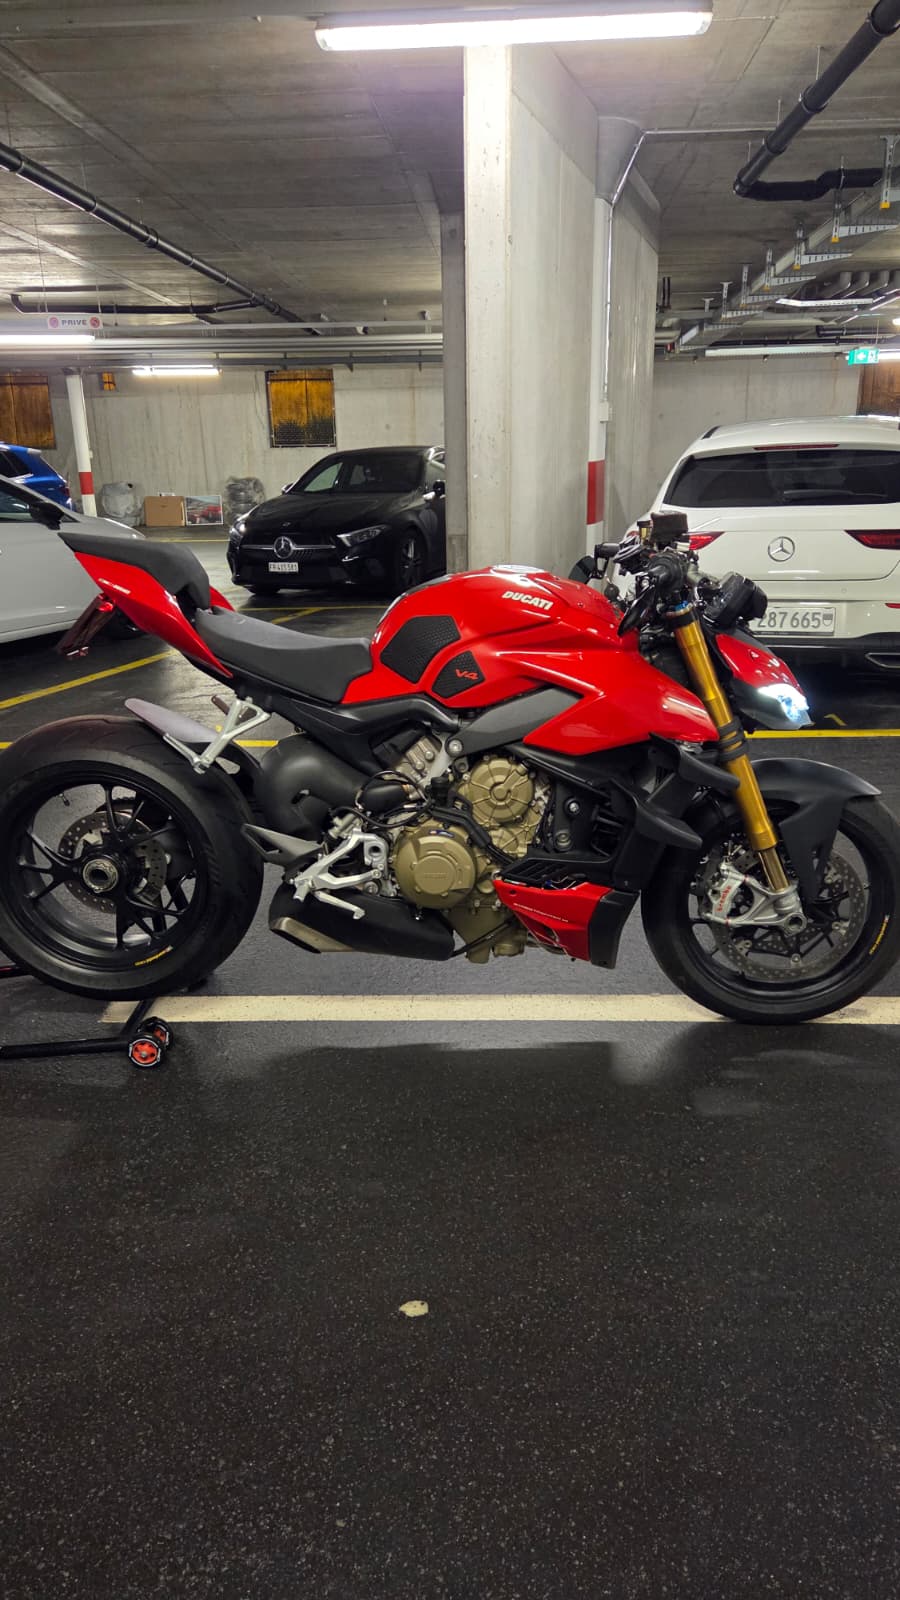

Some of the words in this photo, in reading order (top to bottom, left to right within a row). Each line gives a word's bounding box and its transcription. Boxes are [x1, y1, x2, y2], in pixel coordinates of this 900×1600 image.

[501, 590, 554, 610] DUCATI
[790, 611, 822, 629] 665
[455, 668, 479, 680] V4
